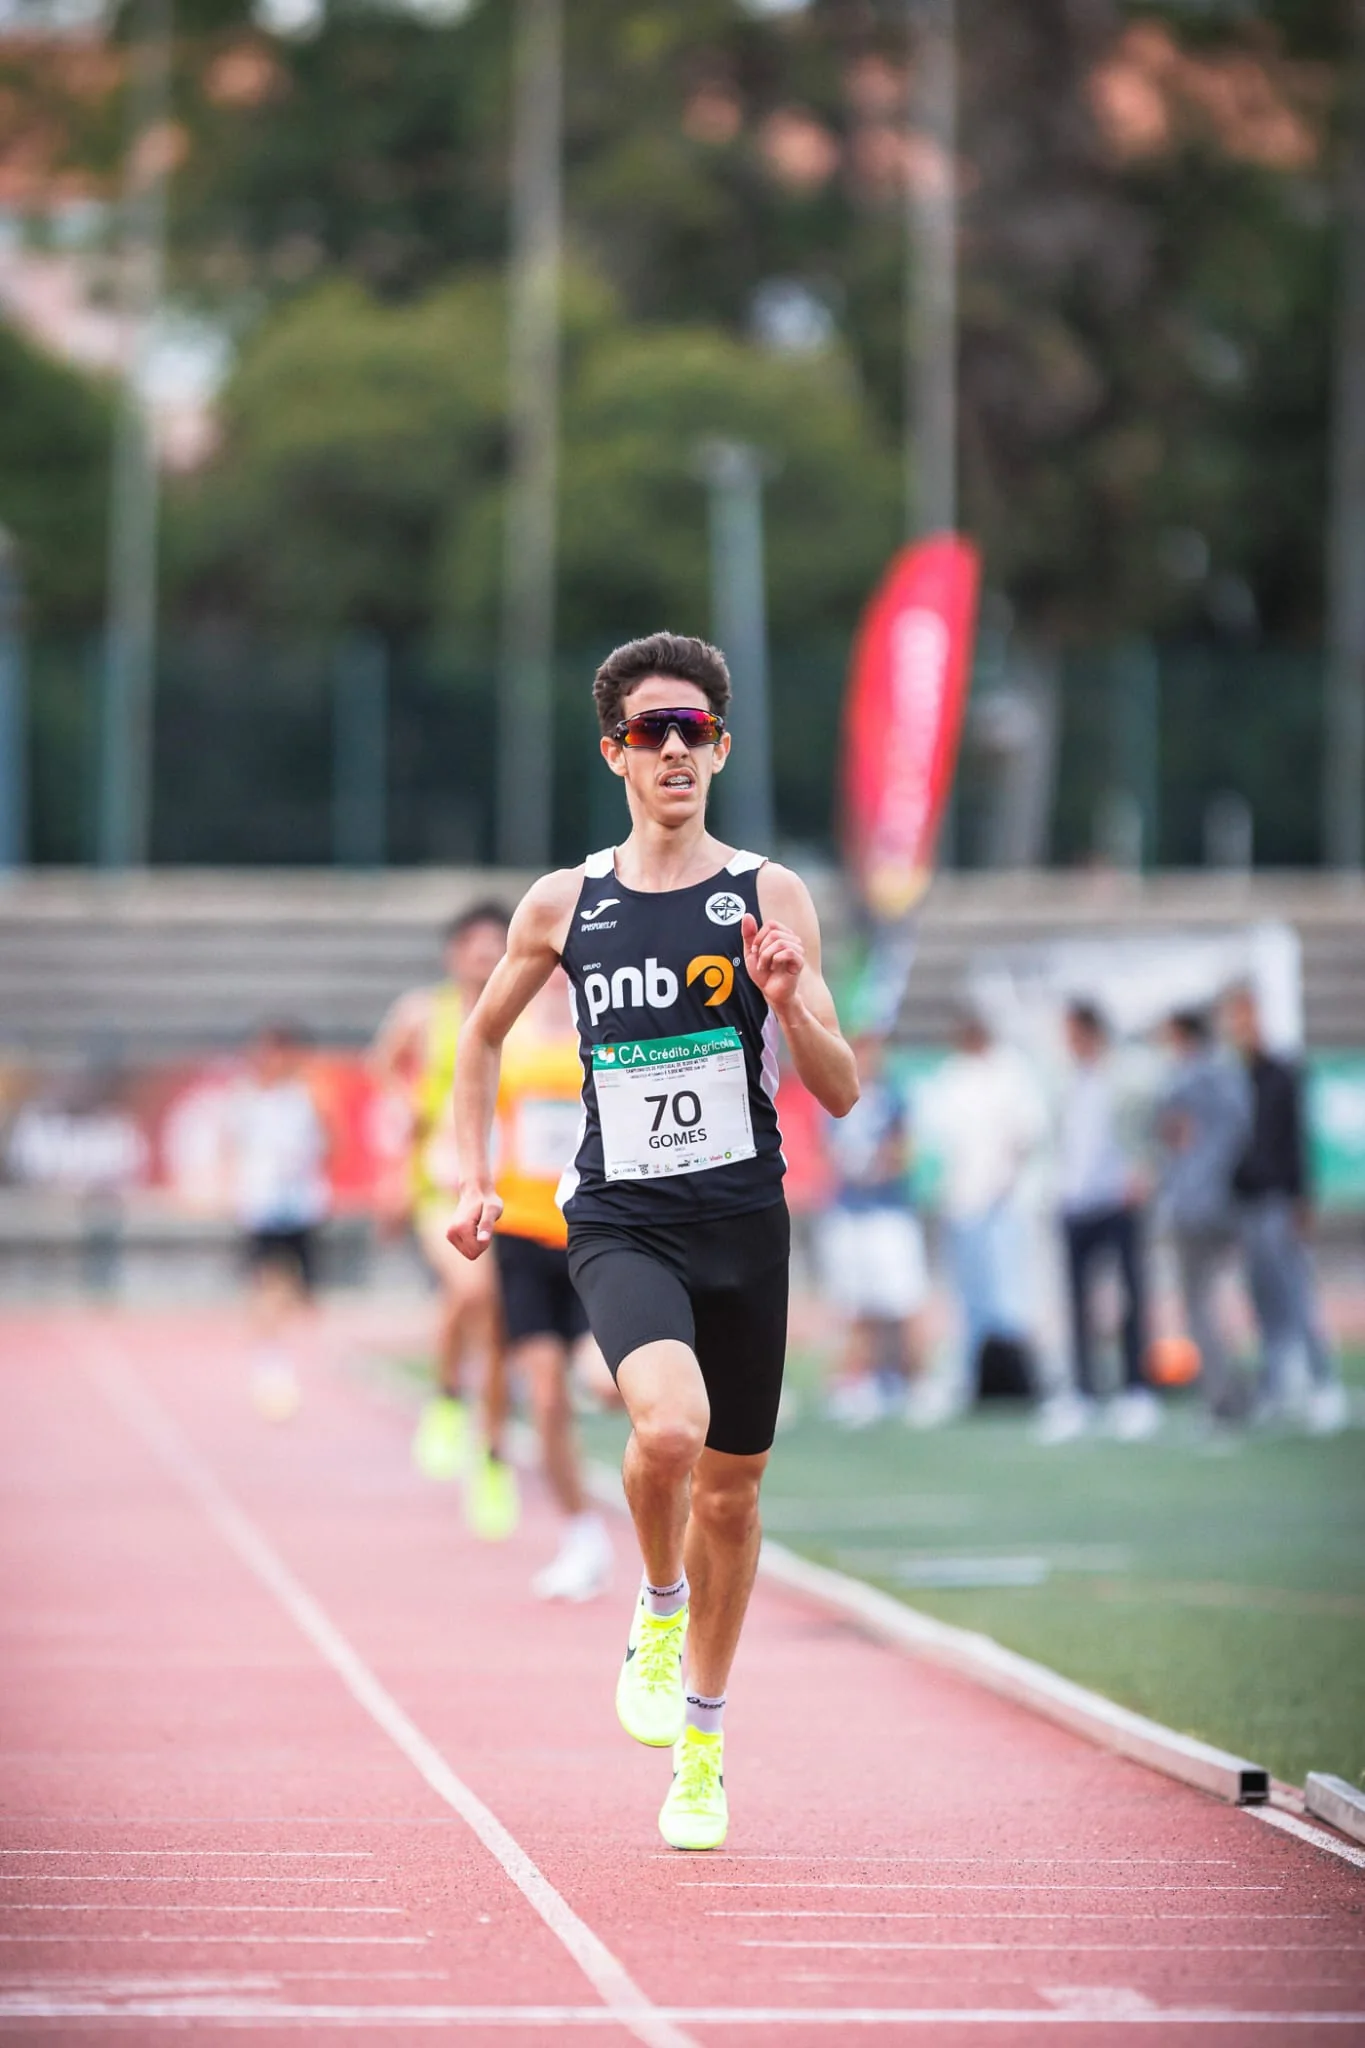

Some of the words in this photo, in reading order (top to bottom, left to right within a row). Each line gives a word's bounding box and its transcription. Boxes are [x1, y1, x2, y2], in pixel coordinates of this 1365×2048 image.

[584, 957, 679, 1027] pnb
[618, 1044, 647, 1064] CA
[649, 1046, 690, 1060] Crédito
[693, 1038, 735, 1055] Agrícola
[644, 1090, 702, 1132] 70
[649, 1128, 707, 1149] GOMES
